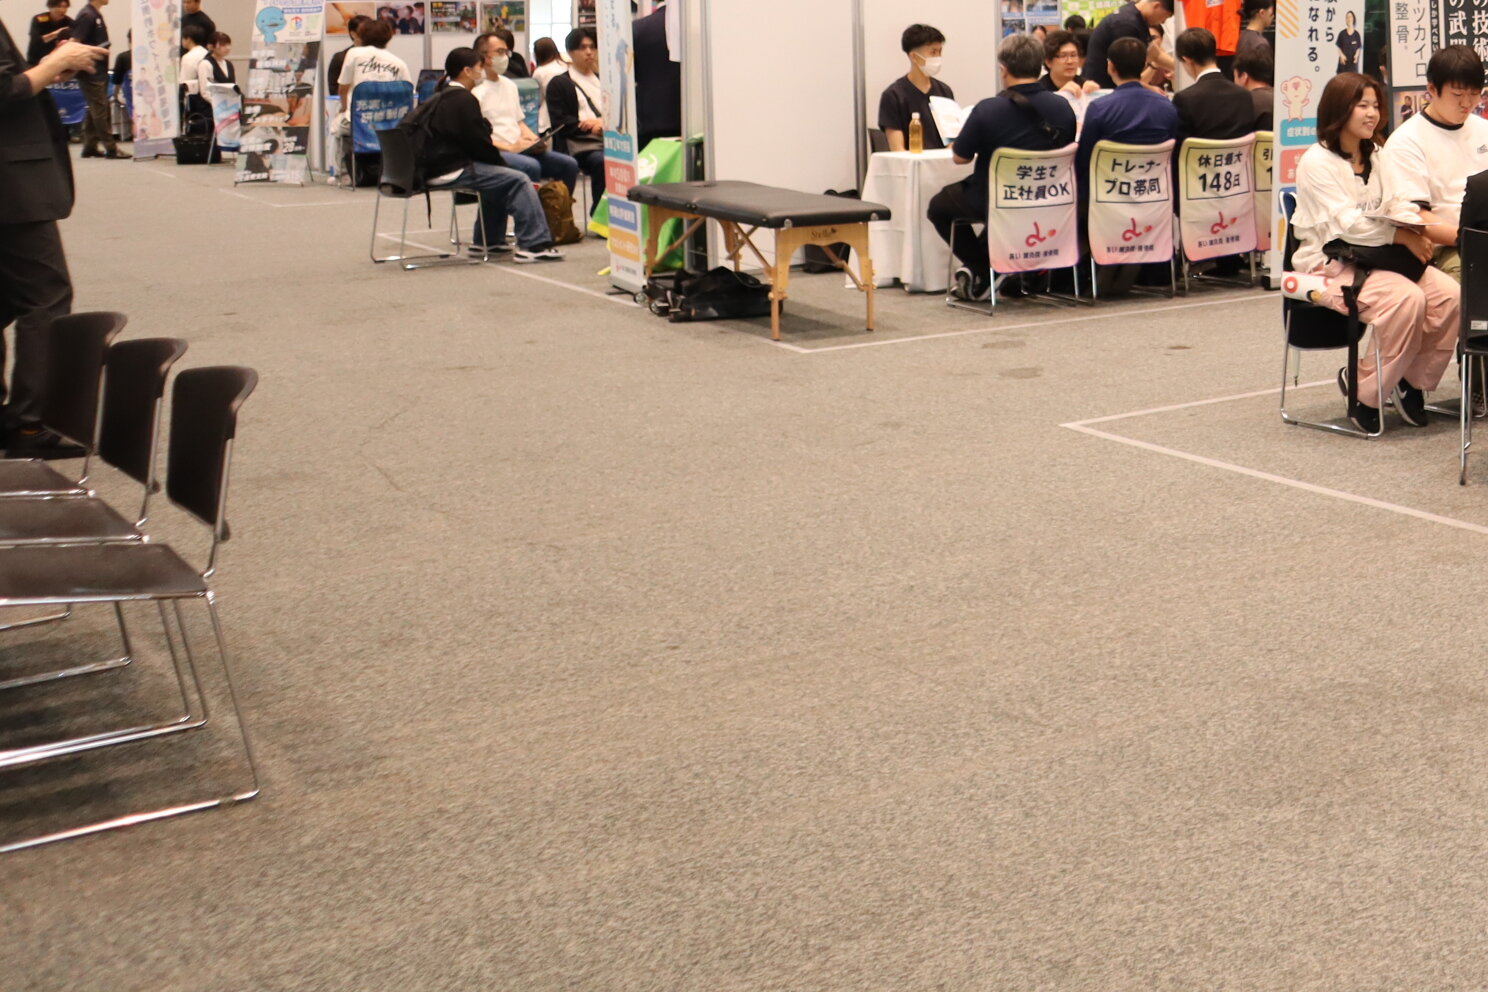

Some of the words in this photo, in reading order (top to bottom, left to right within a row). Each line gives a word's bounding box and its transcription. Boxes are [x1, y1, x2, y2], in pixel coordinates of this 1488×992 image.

[1111, 159, 1161, 173] トレーナー
[1198, 153, 1243, 168] 休日最大
[1016, 165, 1057, 181] 学生で
[1198, 170, 1241, 193] 148日
[1003, 182, 1070, 201] 正社員OK
[1105, 178, 1161, 196] プロ帯同
